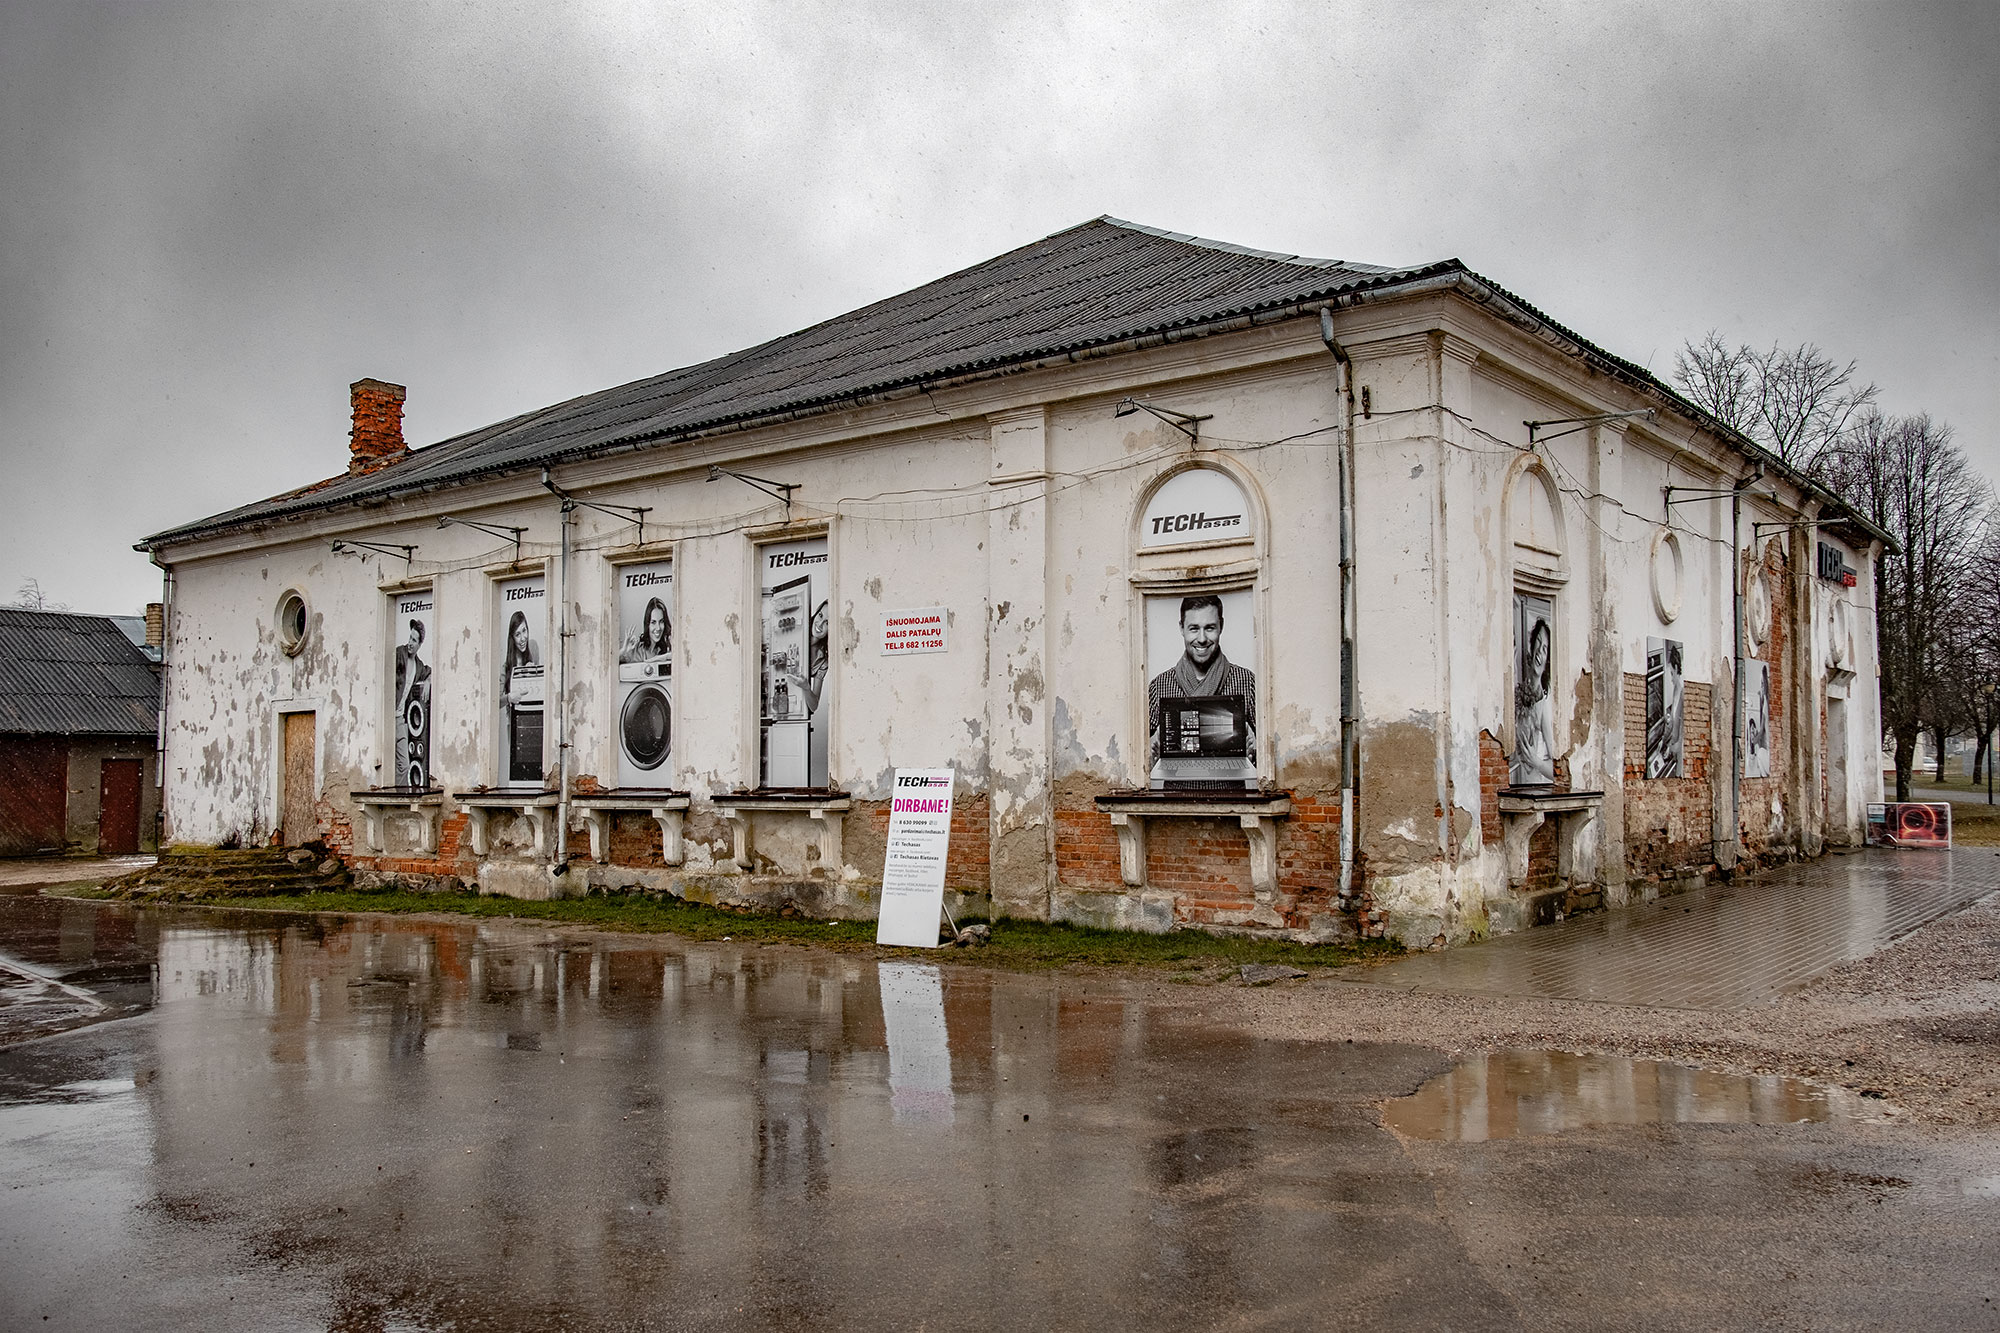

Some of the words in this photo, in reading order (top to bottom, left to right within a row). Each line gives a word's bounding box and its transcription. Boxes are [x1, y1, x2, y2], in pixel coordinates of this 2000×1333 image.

[1152, 512, 1241, 534] TECHasas
[769, 552, 828, 568] TECHasas
[886, 616, 941, 626] IŠNUOMOJAMA
[886, 630, 907, 638] DALIS
[909, 628, 941, 637] PATALPŲ
[898, 777, 949, 787] TECHasas
[893, 798, 949, 813] DIRBAME!
